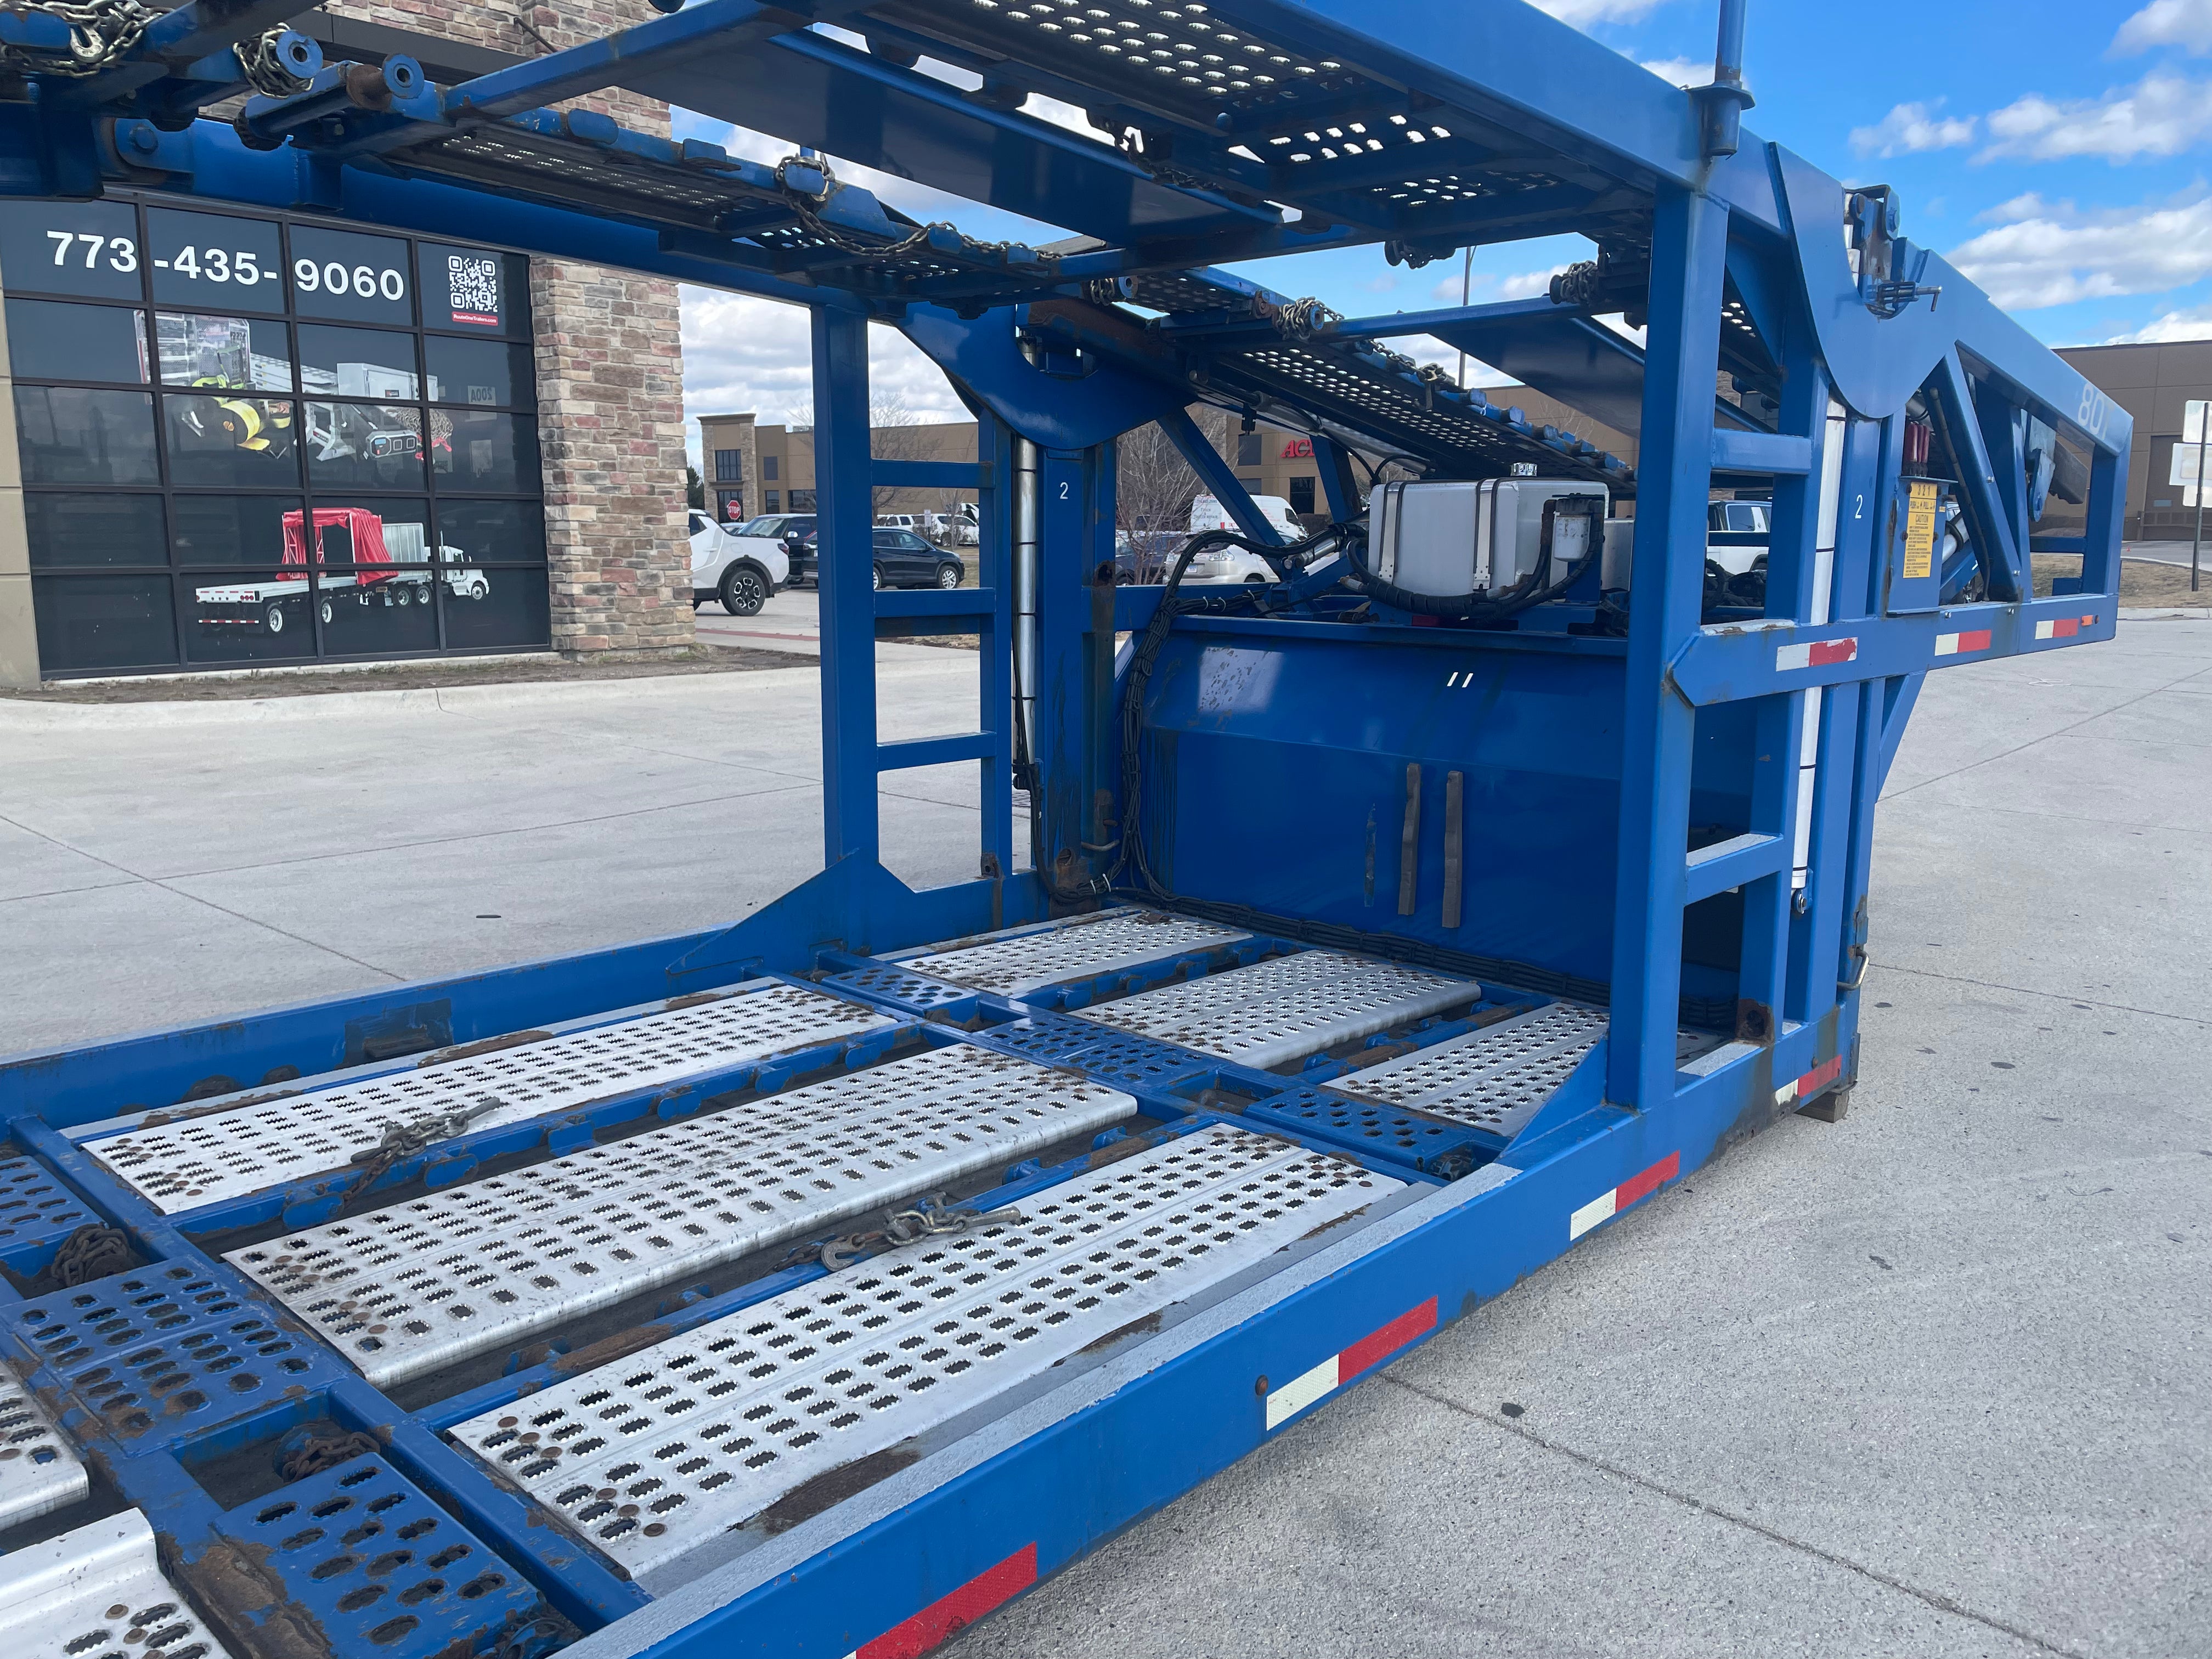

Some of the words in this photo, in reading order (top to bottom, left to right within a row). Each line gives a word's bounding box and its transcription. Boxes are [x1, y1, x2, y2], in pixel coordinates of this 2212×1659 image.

[47, 230, 137, 272] 773
[295, 259, 404, 301] 9060
[1060, 482, 1069, 499] 2
[729, 505, 740, 514] STOP
[1855, 494, 1863, 519] 2
